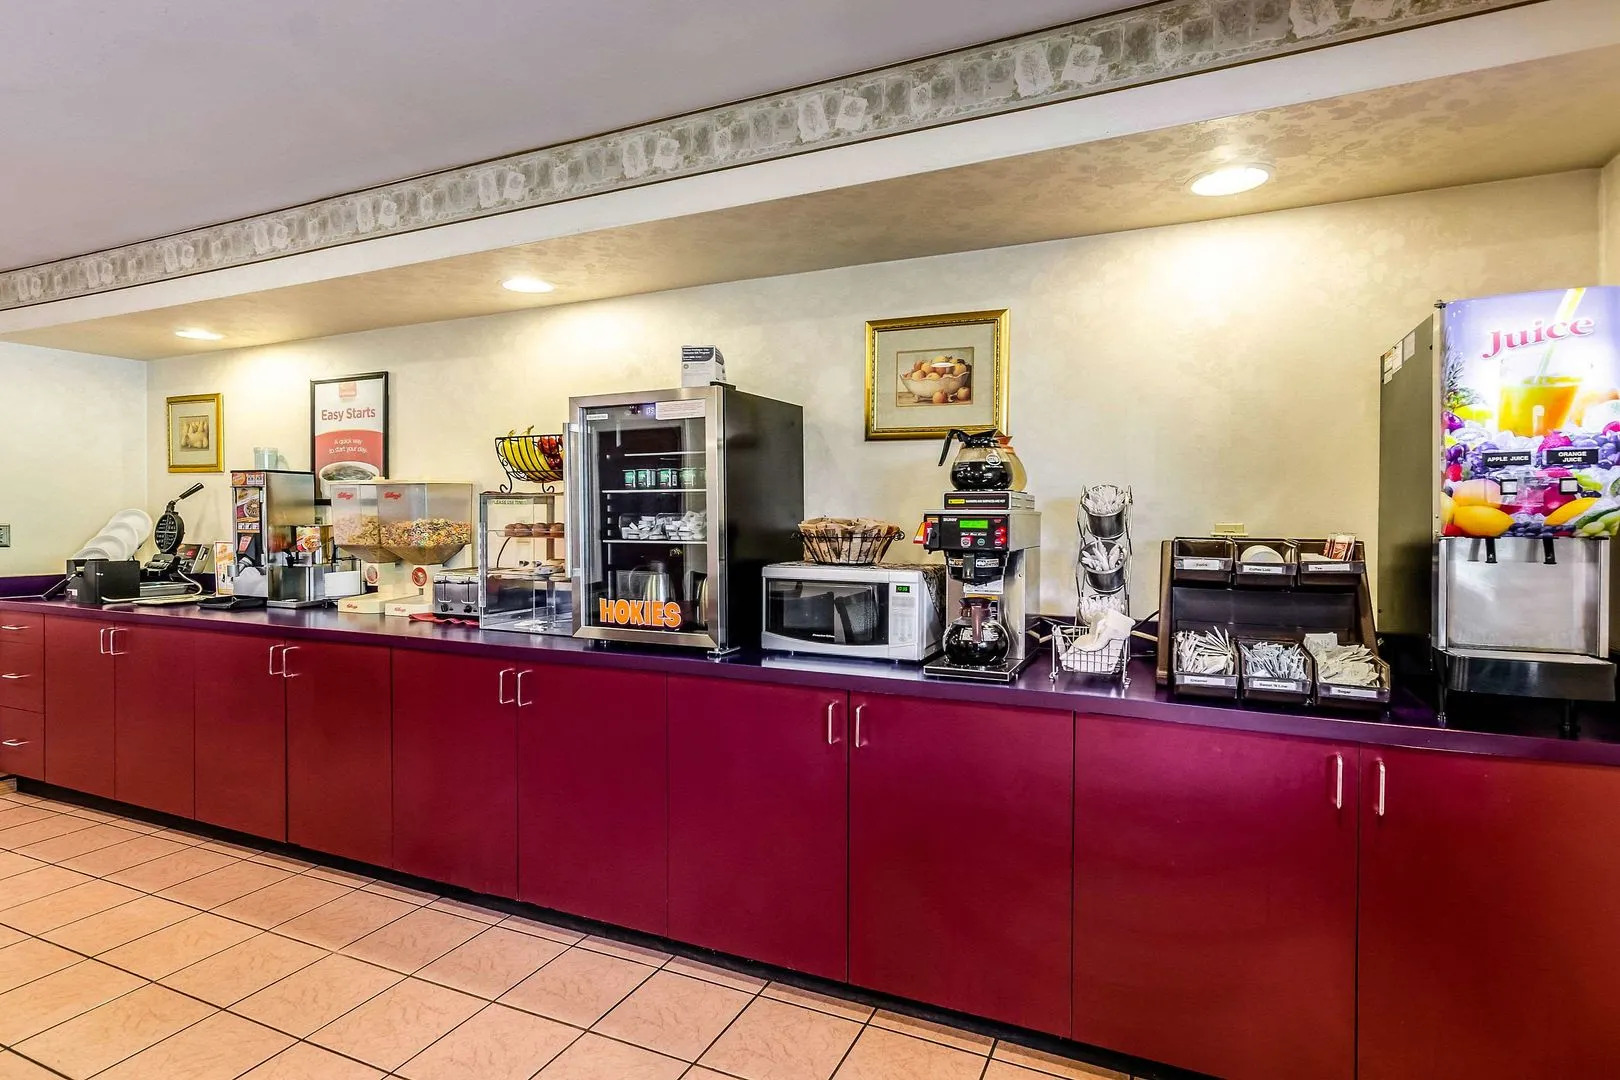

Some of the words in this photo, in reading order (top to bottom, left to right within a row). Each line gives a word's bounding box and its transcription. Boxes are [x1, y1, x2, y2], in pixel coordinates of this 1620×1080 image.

[1482, 319, 1593, 359] Juice
[321, 409, 344, 422] Easy
[346, 407, 376, 420] Starts
[347, 446, 357, 454] your
[599, 598, 682, 628] HOKIES
